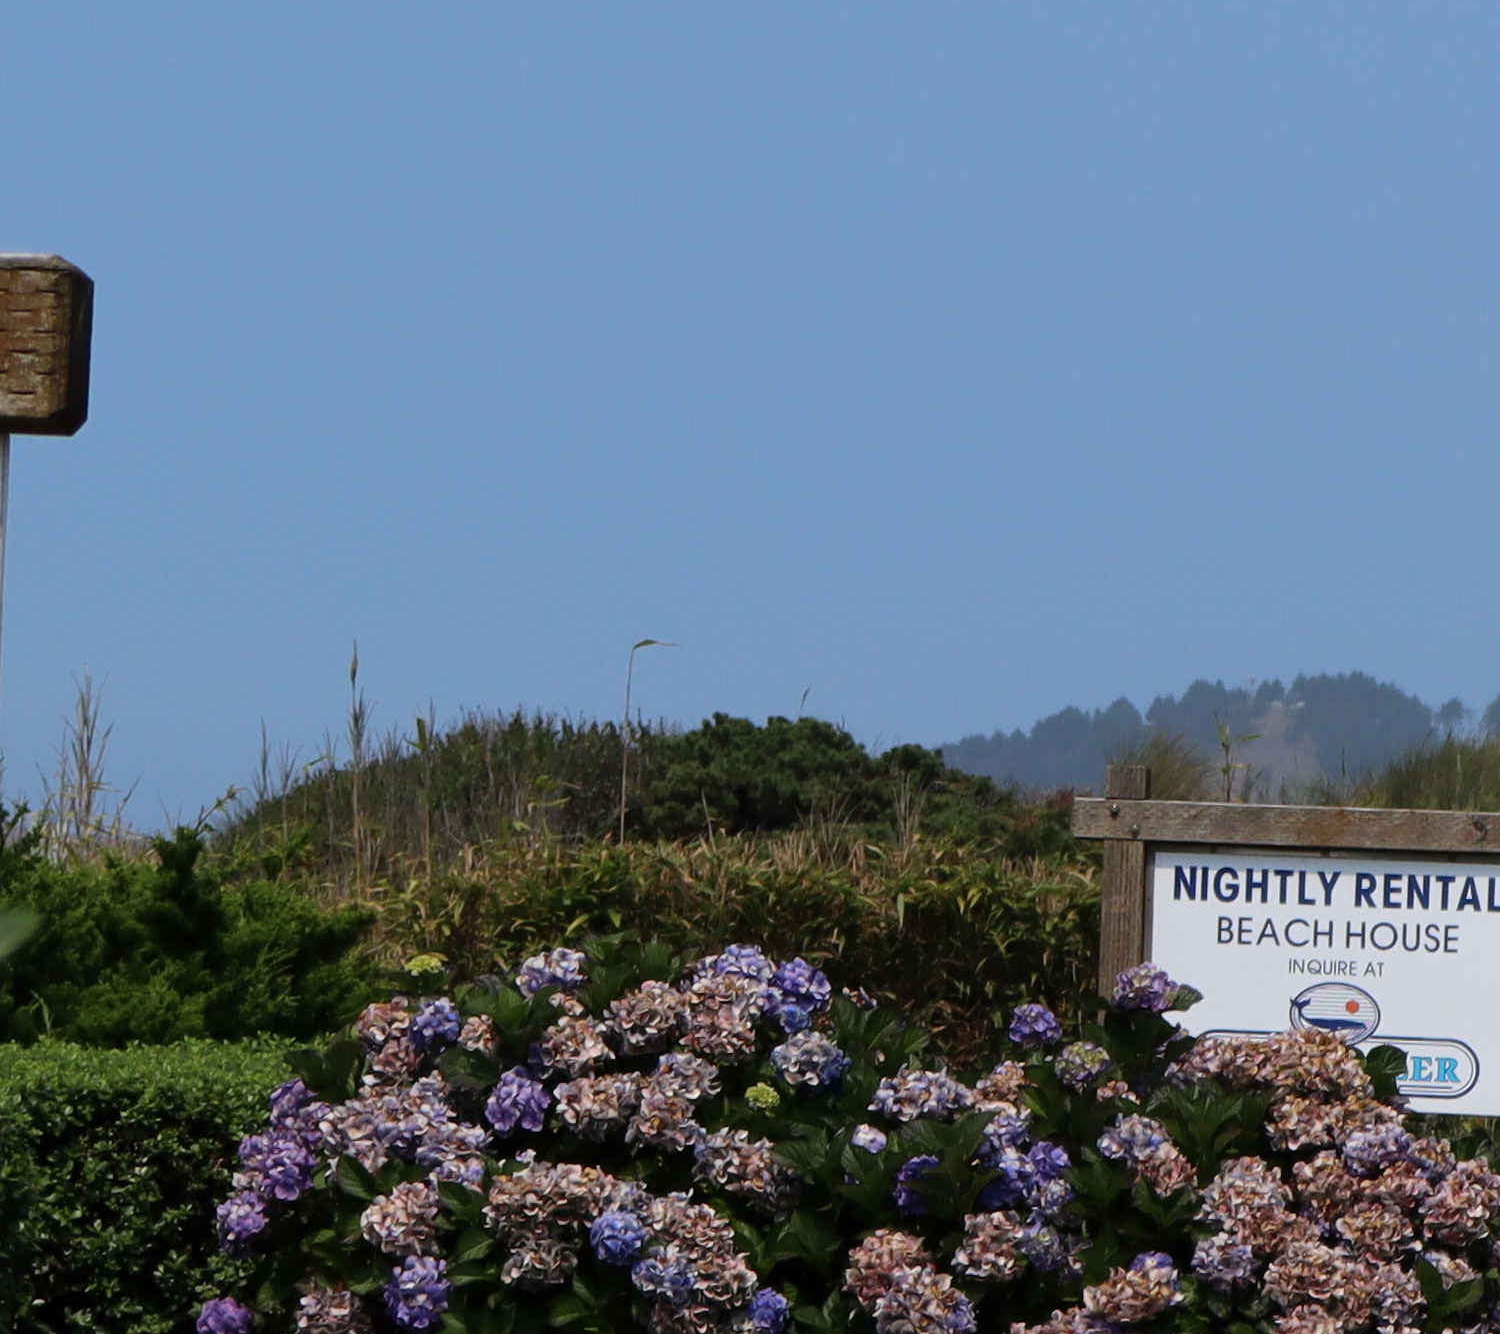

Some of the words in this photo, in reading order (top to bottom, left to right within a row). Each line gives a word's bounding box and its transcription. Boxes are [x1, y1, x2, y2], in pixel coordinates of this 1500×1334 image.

[1173, 864, 1343, 906] NIGHTLY
[1217, 916, 1334, 948] BEACH
[1345, 921, 1459, 953] HOUSE
[1288, 958, 1357, 976] INQUIRE
[1363, 961, 1385, 977] AT
